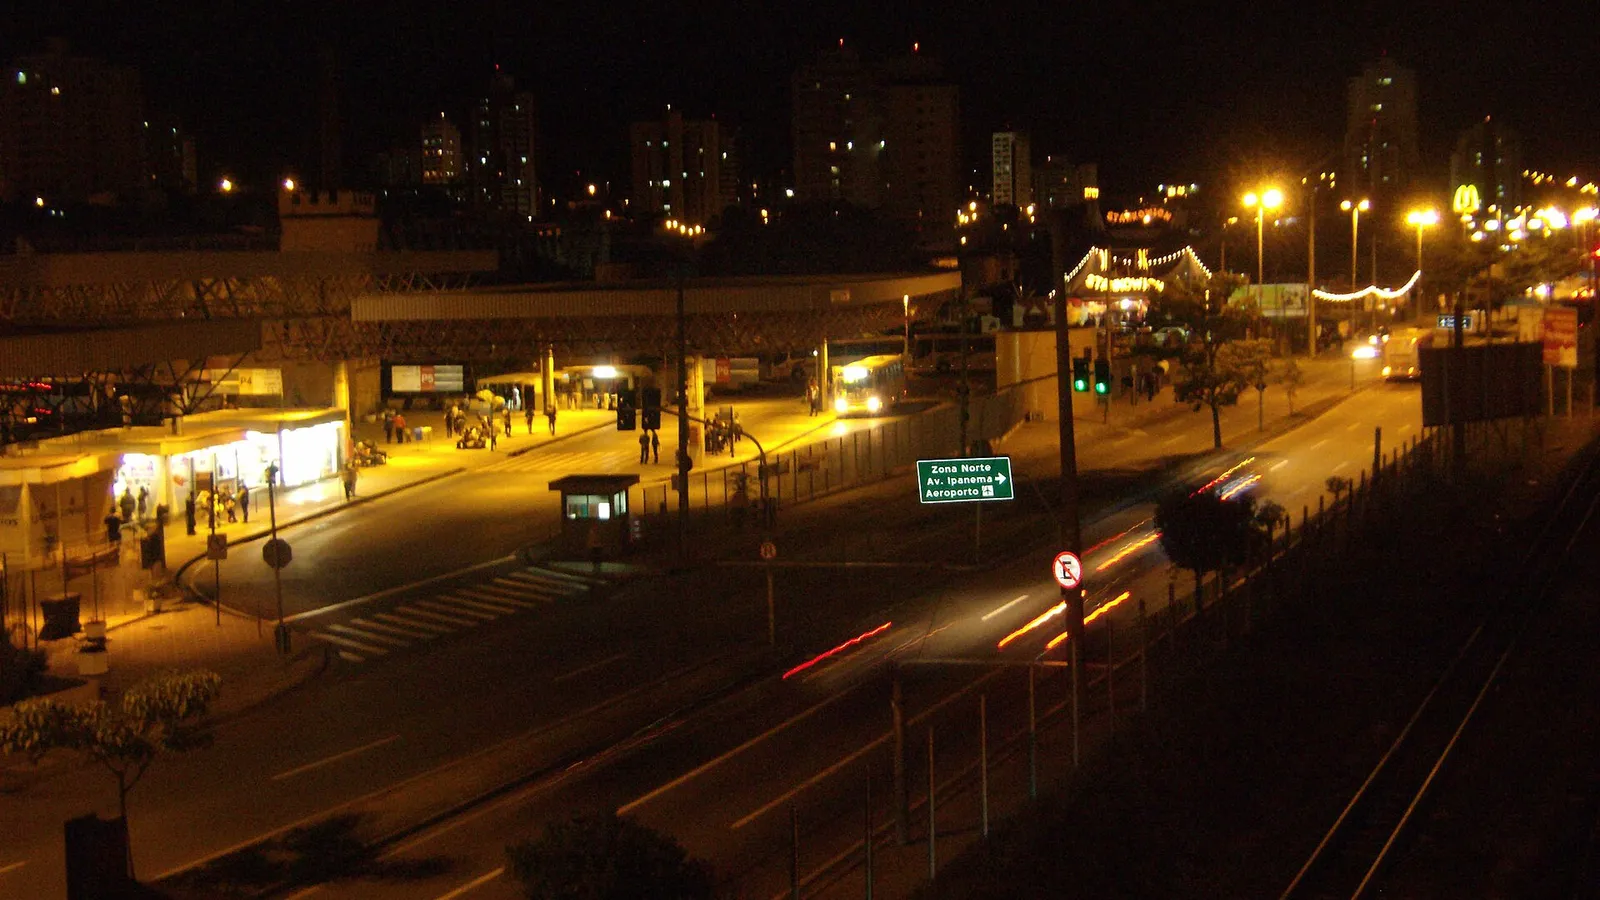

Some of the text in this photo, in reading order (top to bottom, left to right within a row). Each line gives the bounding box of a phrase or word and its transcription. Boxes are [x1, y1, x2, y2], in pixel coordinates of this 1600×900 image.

[931, 463, 991, 474] Zona Norte
[926, 476, 993, 486] Av. Ipanema
[925, 488, 979, 498] Aeroporto
[1062, 561, 1072, 579] E
